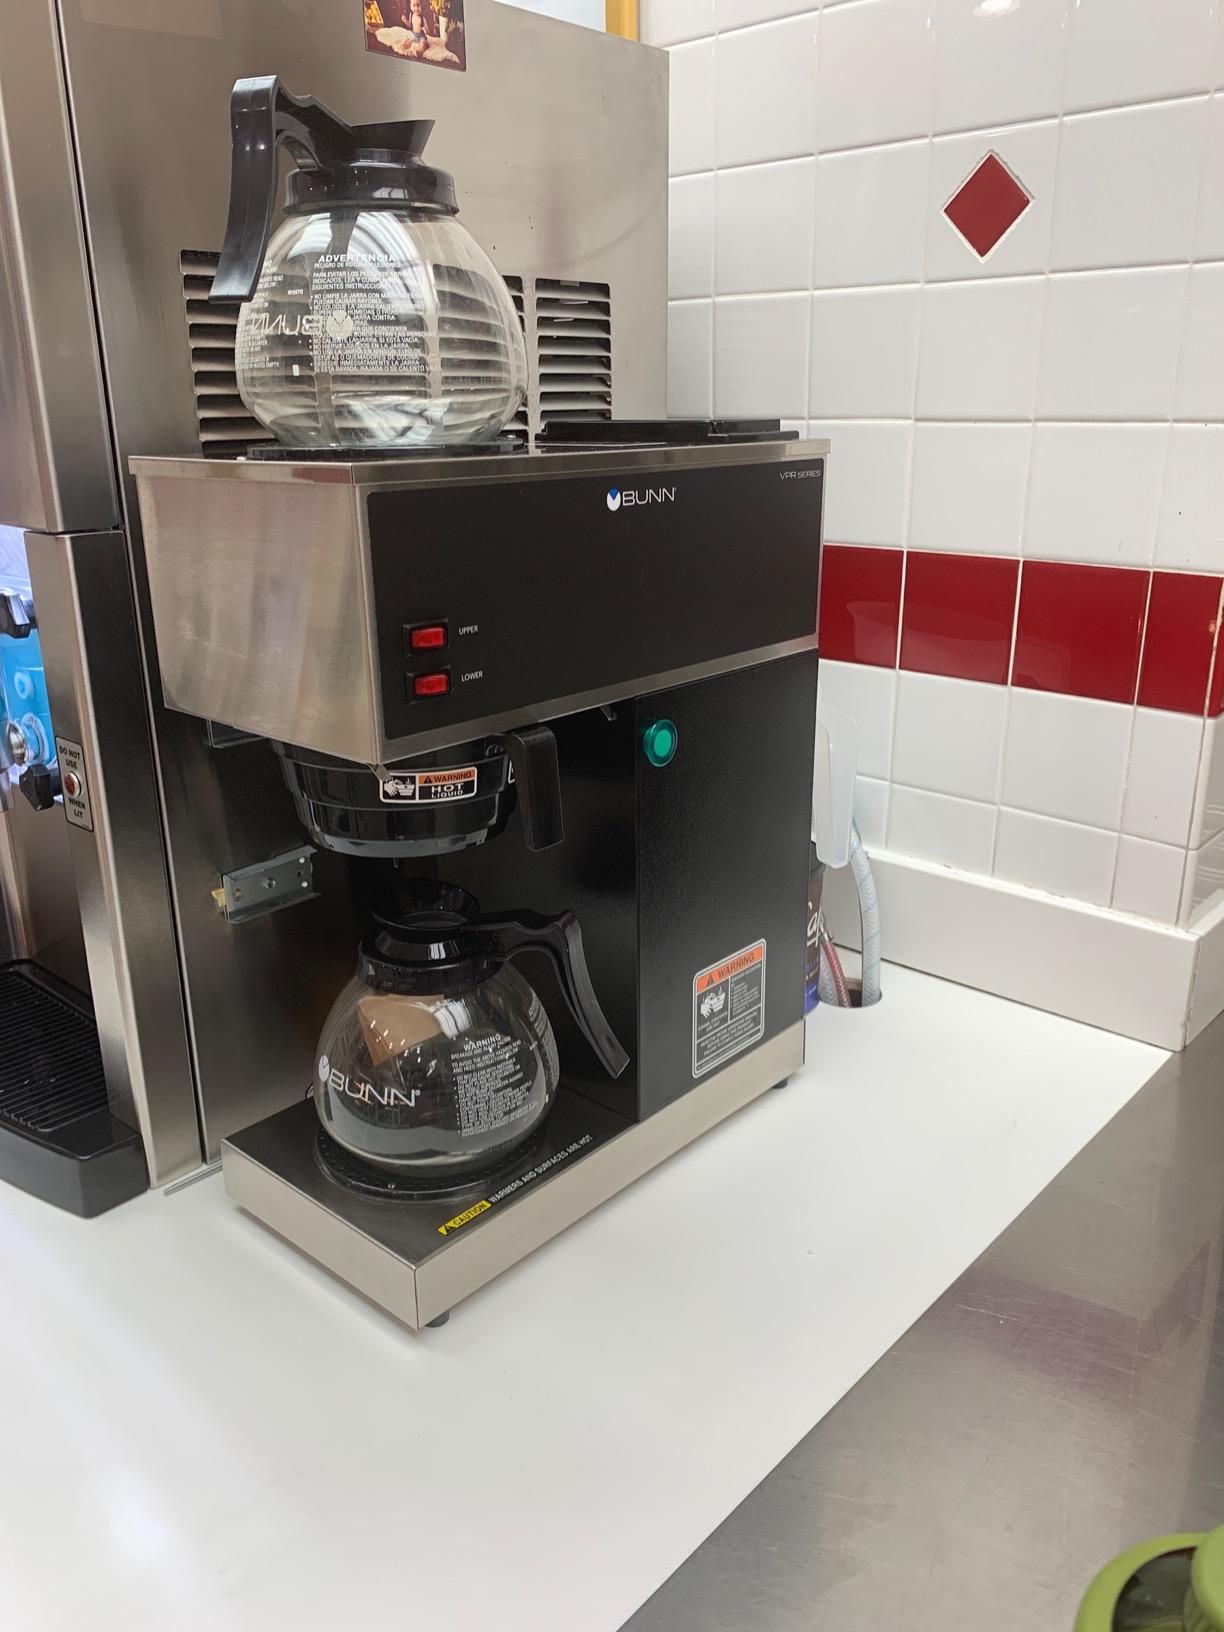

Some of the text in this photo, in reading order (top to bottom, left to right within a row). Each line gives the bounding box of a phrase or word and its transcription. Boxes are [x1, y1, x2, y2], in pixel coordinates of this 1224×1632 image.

[318, 254, 396, 263] ADVERTENCIA
[779, 470, 821, 480] VPR SERIES
[622, 487, 676, 507] BUNN
[458, 624, 479, 635] UPPER
[461, 670, 483, 682] LOWER
[59, 746, 80, 760] DO NOT
[65, 758, 78, 770] USE
[433, 771, 472, 783] WARNING
[431, 782, 464, 793] HOT
[431, 790, 463, 798] LIQUID
[69, 797, 86, 810] WHEN
[73, 809, 83, 819] LIT
[718, 952, 755, 978] WARNING
[463, 1033, 501, 1051] WARNING
[329, 1067, 415, 1107] BUNN
[453, 1134, 593, 1226] CAUTION WARMERS AND SURFACES ARE HOT
